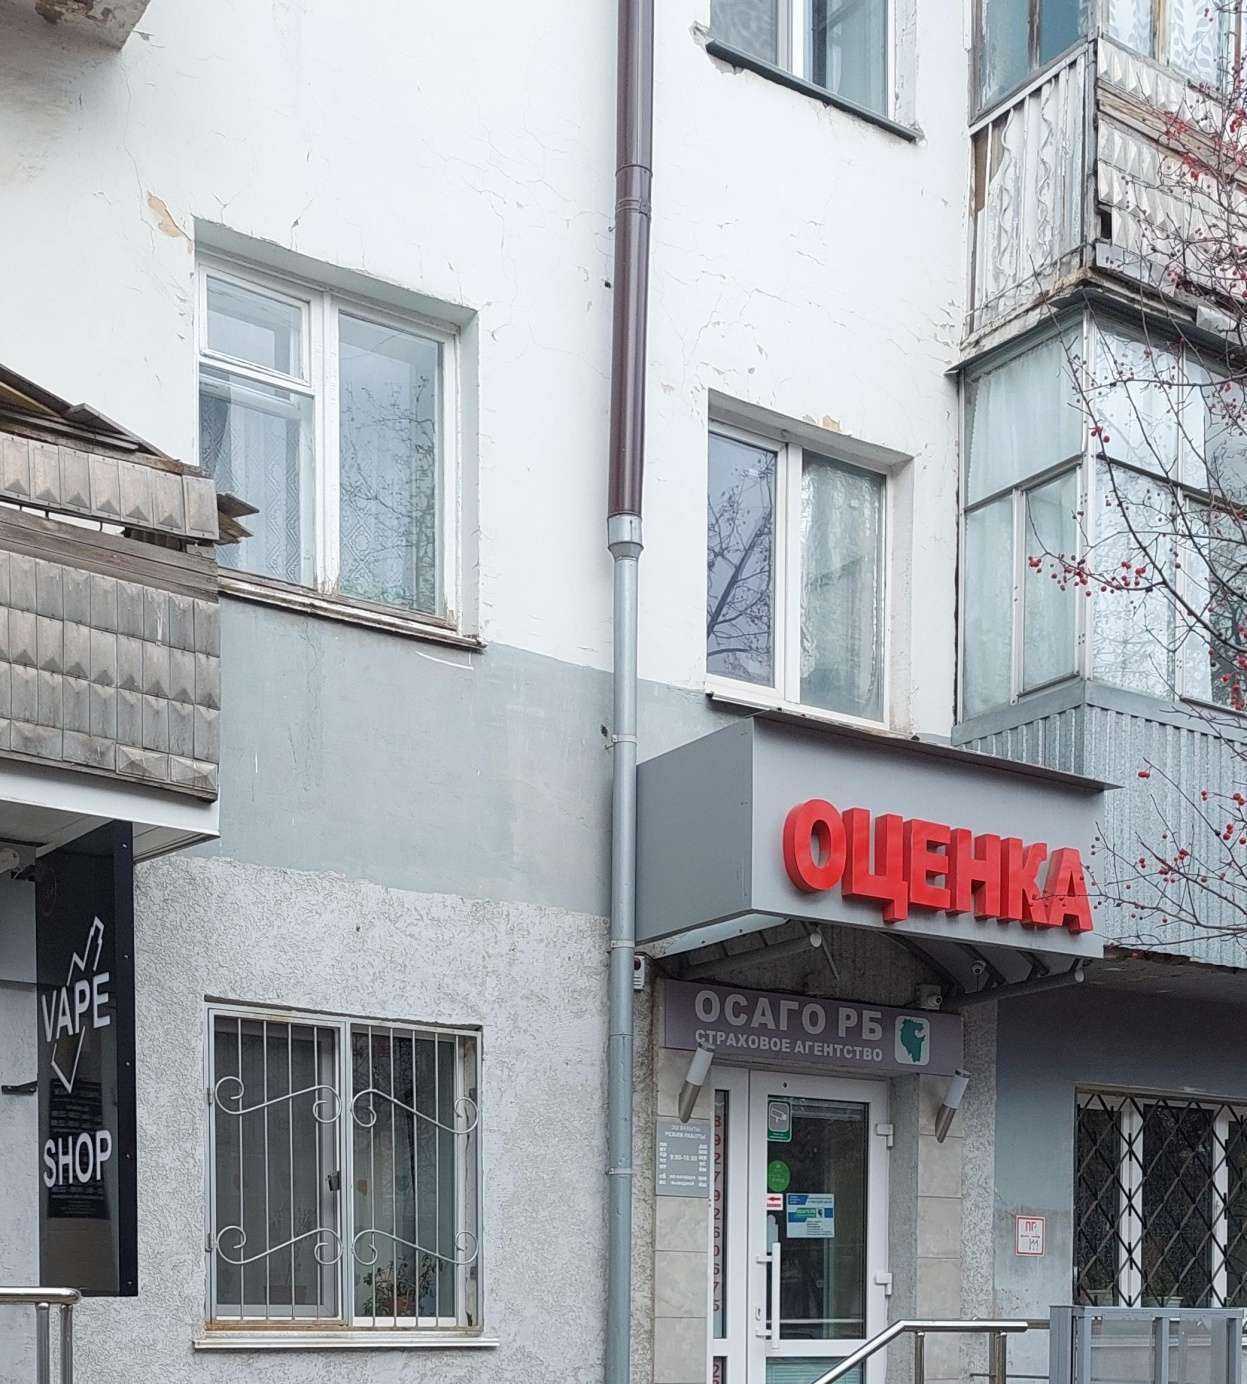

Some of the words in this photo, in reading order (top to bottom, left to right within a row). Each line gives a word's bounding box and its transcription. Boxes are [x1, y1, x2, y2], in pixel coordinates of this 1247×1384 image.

[783, 798, 1094, 935] ОЦЕНКА
[41, 972, 111, 1042] VAPE
[695, 990, 826, 1034] ОСАГО
[838, 1006, 882, 1041] РБ
[695, 1029, 790, 1052] СТРАХОВОЕ
[794, 1040, 882, 1062] АГЕНТСТВО
[43, 1130, 112, 1188] SHOP
